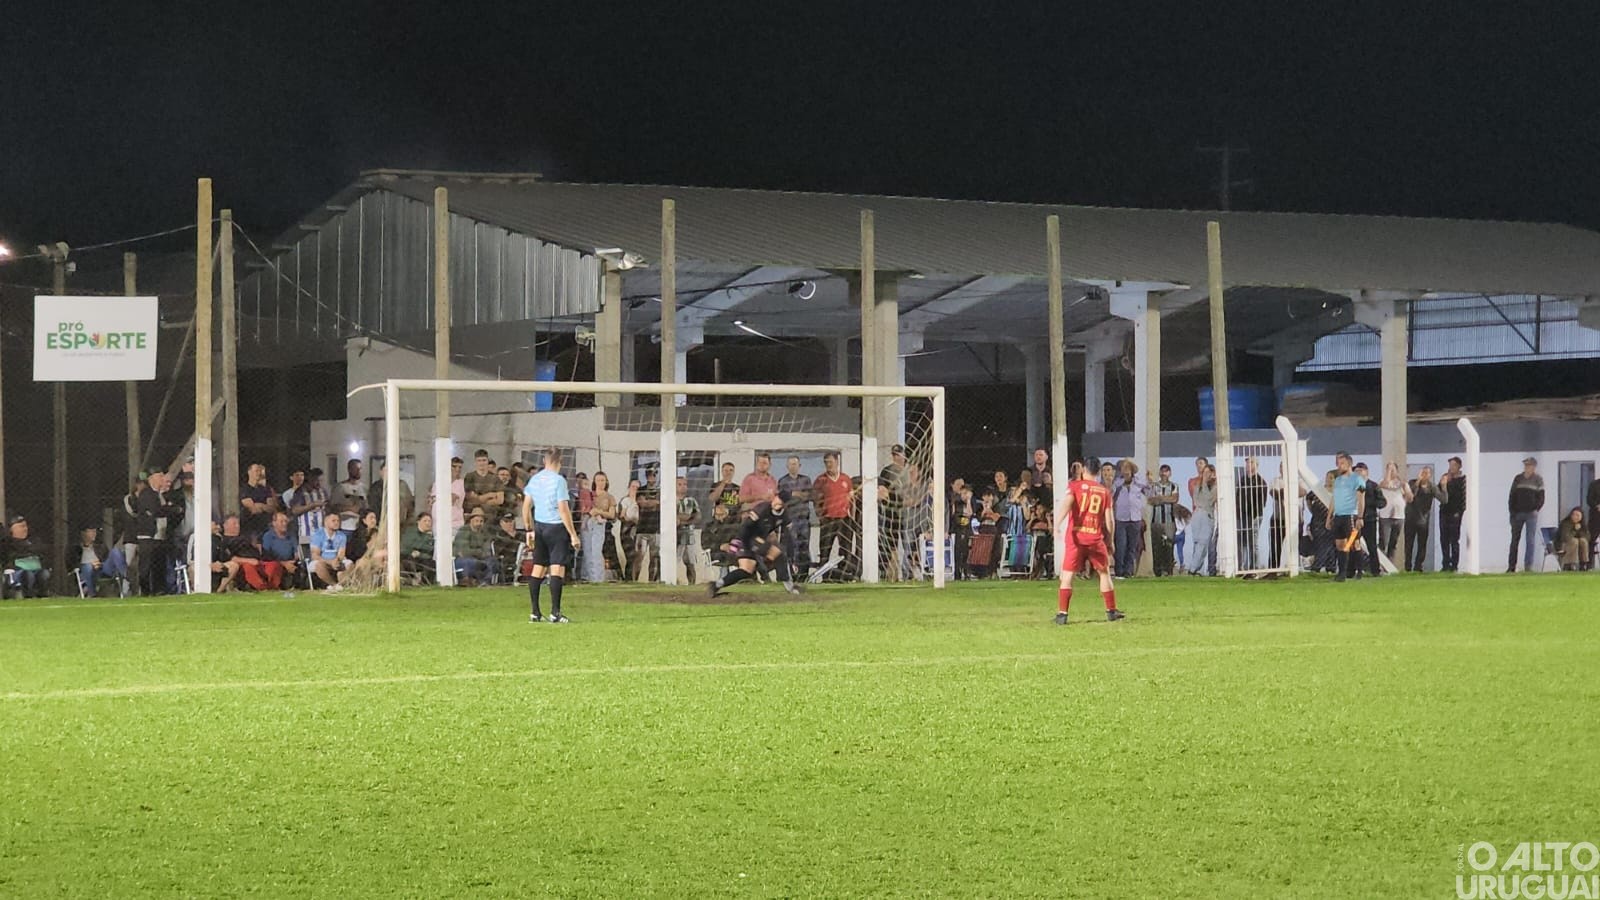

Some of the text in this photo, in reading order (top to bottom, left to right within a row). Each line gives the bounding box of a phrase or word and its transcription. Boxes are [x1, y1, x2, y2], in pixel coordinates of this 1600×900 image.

[58, 320, 84, 332] pró
[46, 332, 147, 349] ESPORTE
[1079, 492, 1102, 514] 18
